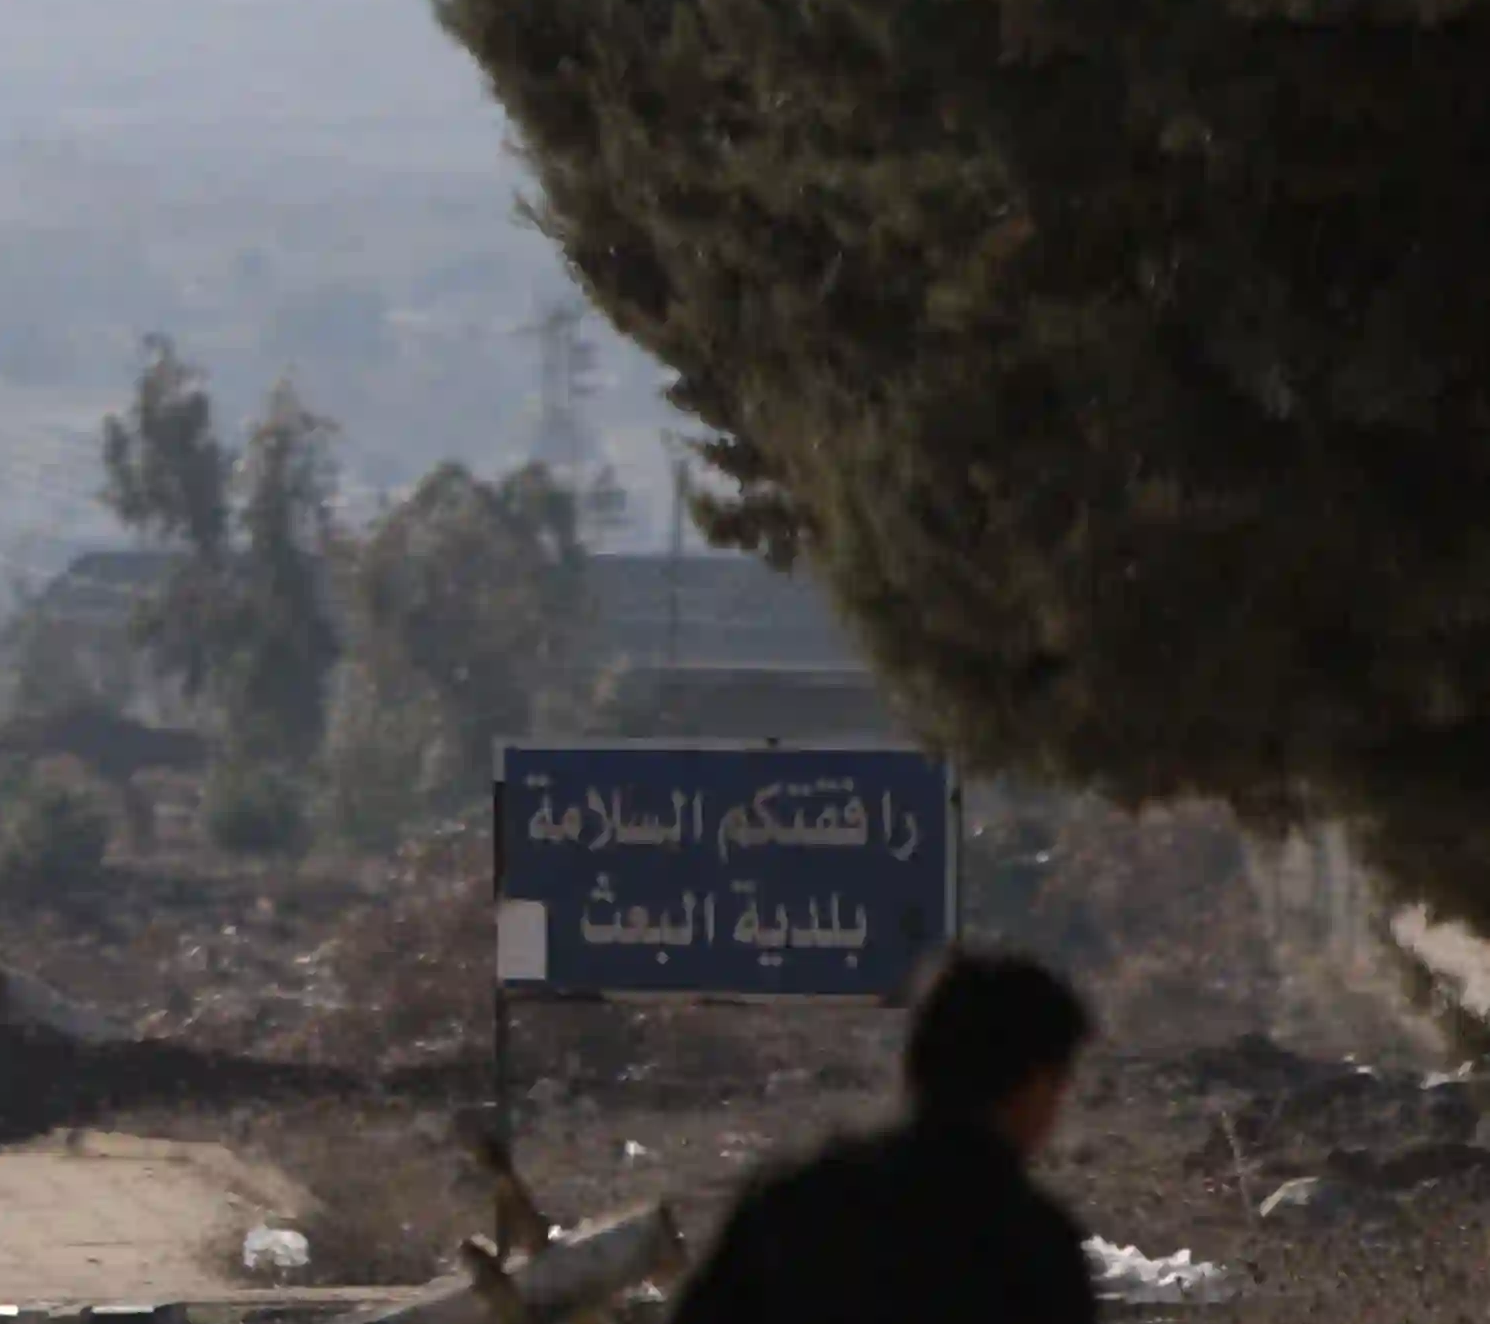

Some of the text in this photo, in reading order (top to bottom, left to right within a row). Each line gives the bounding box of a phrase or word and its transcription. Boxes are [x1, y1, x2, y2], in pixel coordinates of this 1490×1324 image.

[525, 774, 919, 863] رافقتكم السلامة
[580, 872, 868, 968] بلدية البعث
